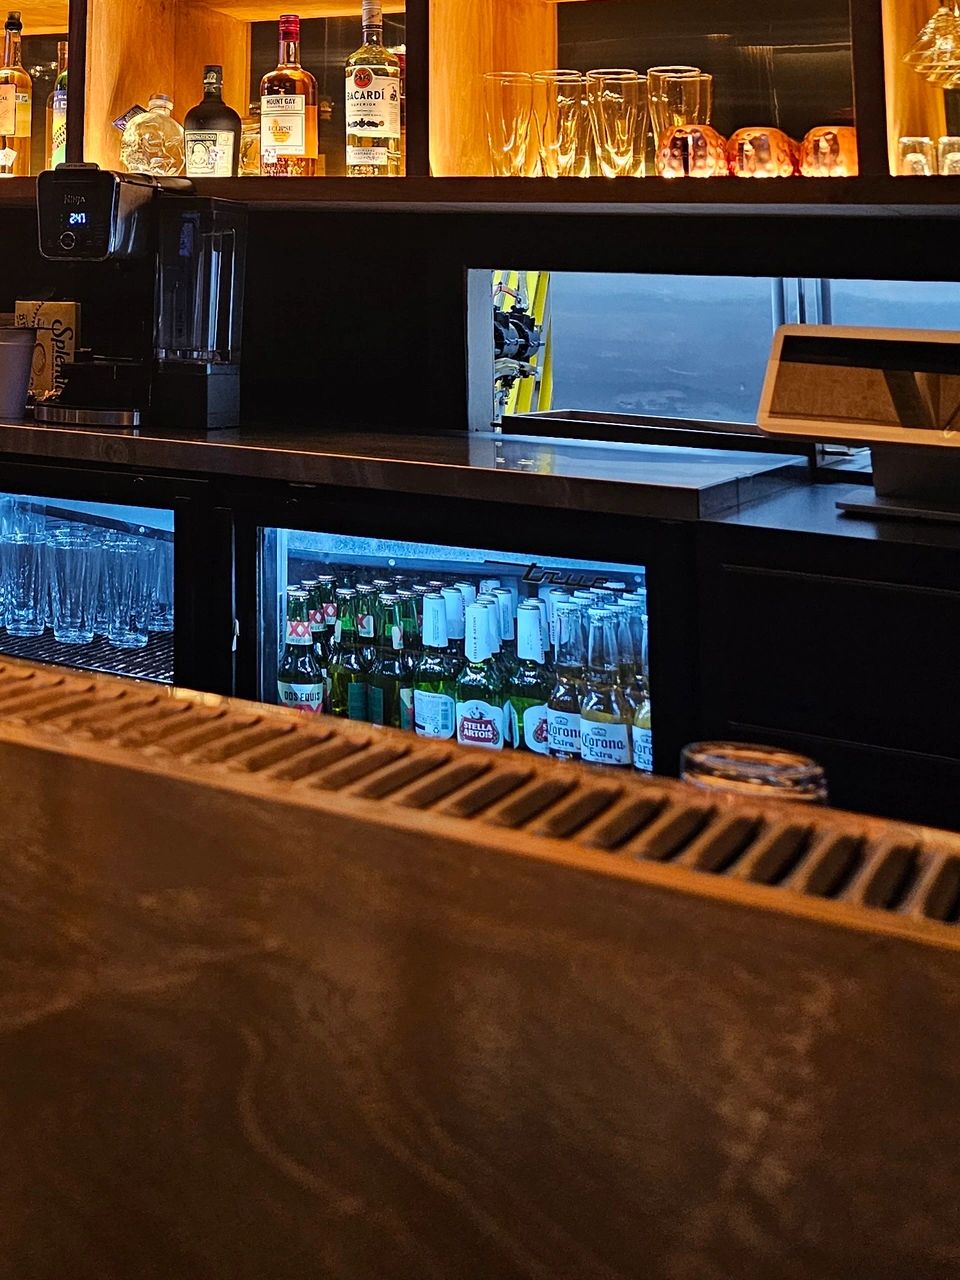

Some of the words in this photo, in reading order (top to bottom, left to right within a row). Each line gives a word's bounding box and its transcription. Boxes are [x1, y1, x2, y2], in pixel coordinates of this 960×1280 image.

[64, 193, 86, 206] NINJA
[522, 563, 609, 588] true
[284, 691, 298, 700] DOS
[300, 692, 320, 701] EQUIS
[463, 721, 493, 731] STELLA
[463, 728, 493, 739] ARTOIS
[552, 735, 575, 747] Extra
[582, 734, 625, 750] Corona
[589, 748, 613, 760] Extra
